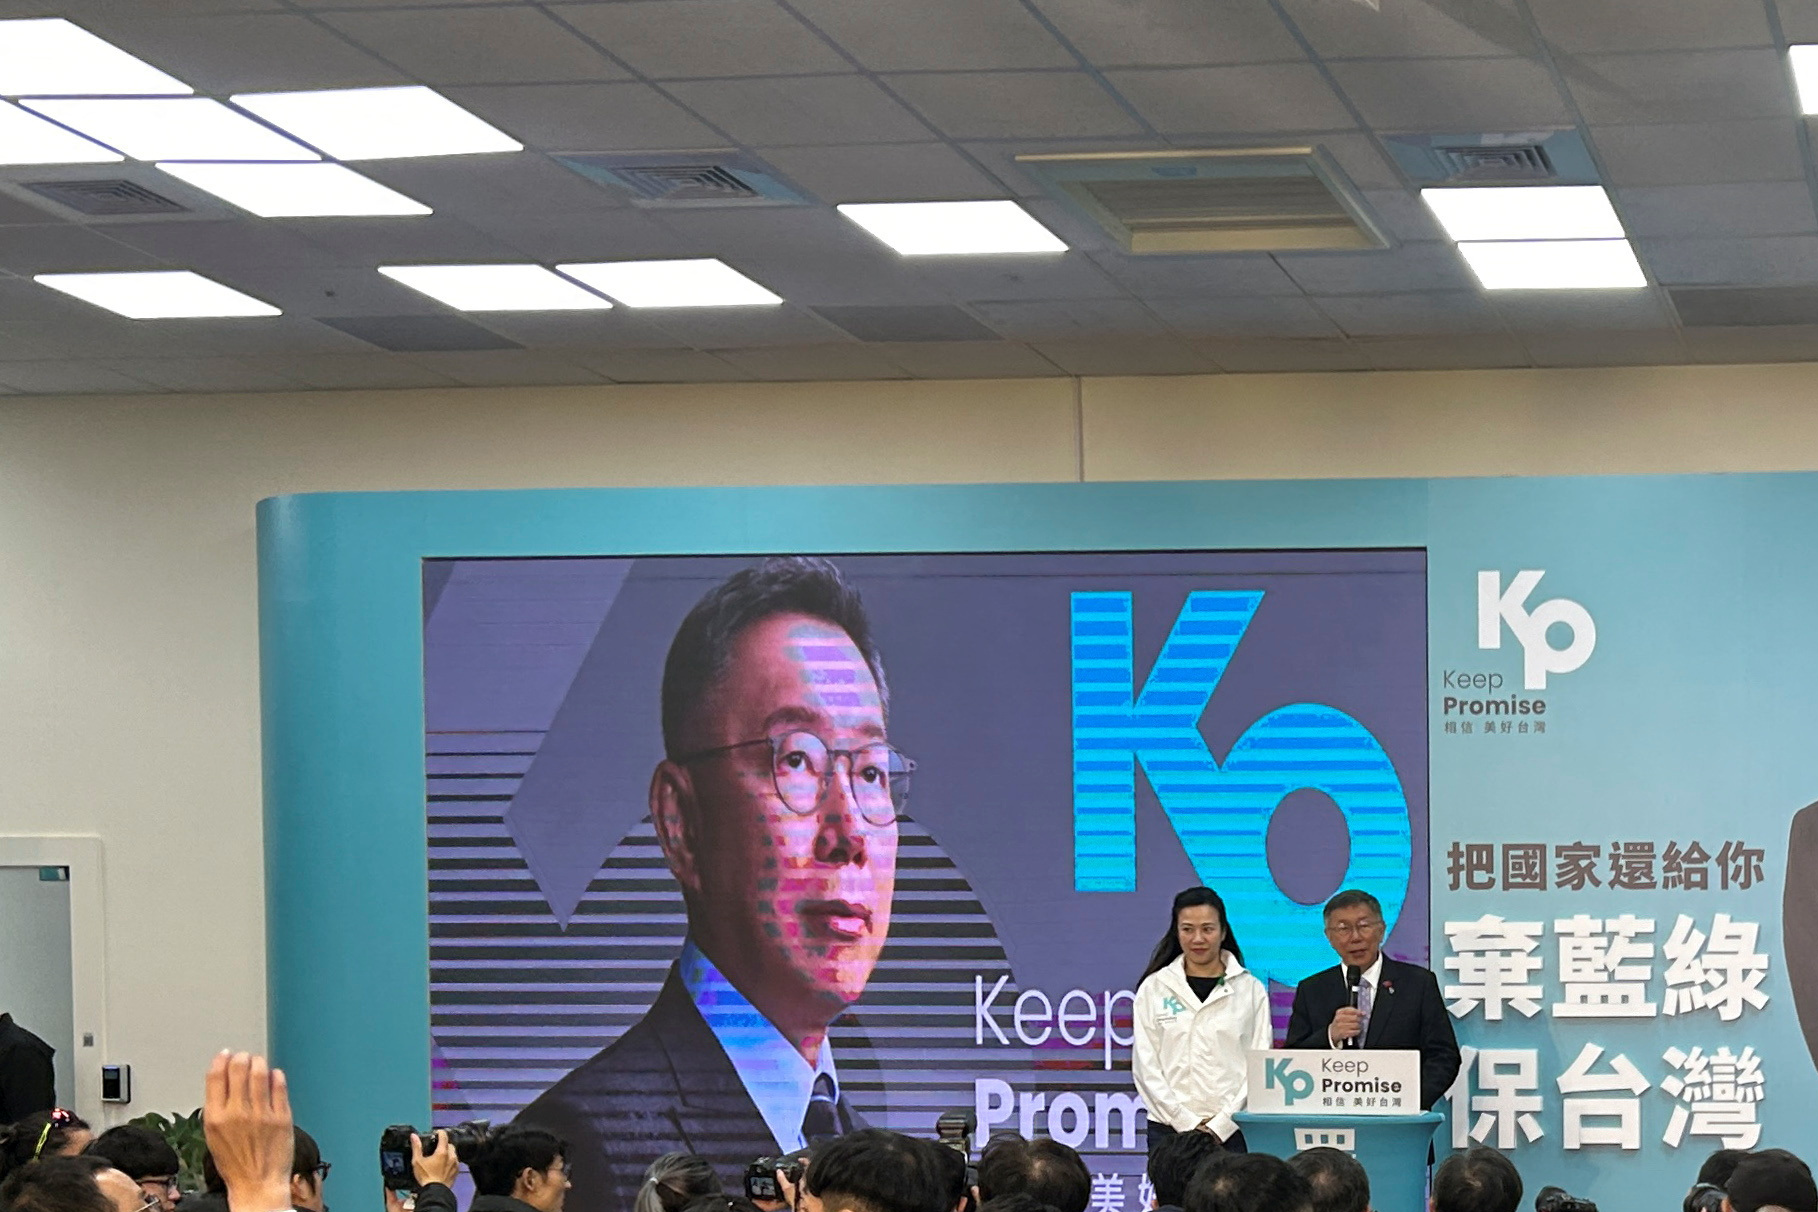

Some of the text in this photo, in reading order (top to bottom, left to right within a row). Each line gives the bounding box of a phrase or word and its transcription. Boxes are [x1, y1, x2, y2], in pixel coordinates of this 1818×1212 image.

[1477, 570, 1596, 690] Kp
[1443, 670, 1504, 694] Keep
[1443, 694, 1546, 716] Promise
[1444, 721, 1547, 735] 相信 美好台灣
[1446, 840, 1767, 892] 把國家還給你
[1443, 913, 1771, 1022] 棄藍綠
[974, 974, 1137, 1071] Keep
[1265, 1057, 1315, 1106] Kp
[1321, 1058, 1369, 1077] Keep
[1321, 1077, 1402, 1094] Promise
[974, 1077, 1148, 1150] Prom
[1353, 1096, 1402, 1108] 美好台灣
[1443, 1042, 1766, 1152] 保台灣
